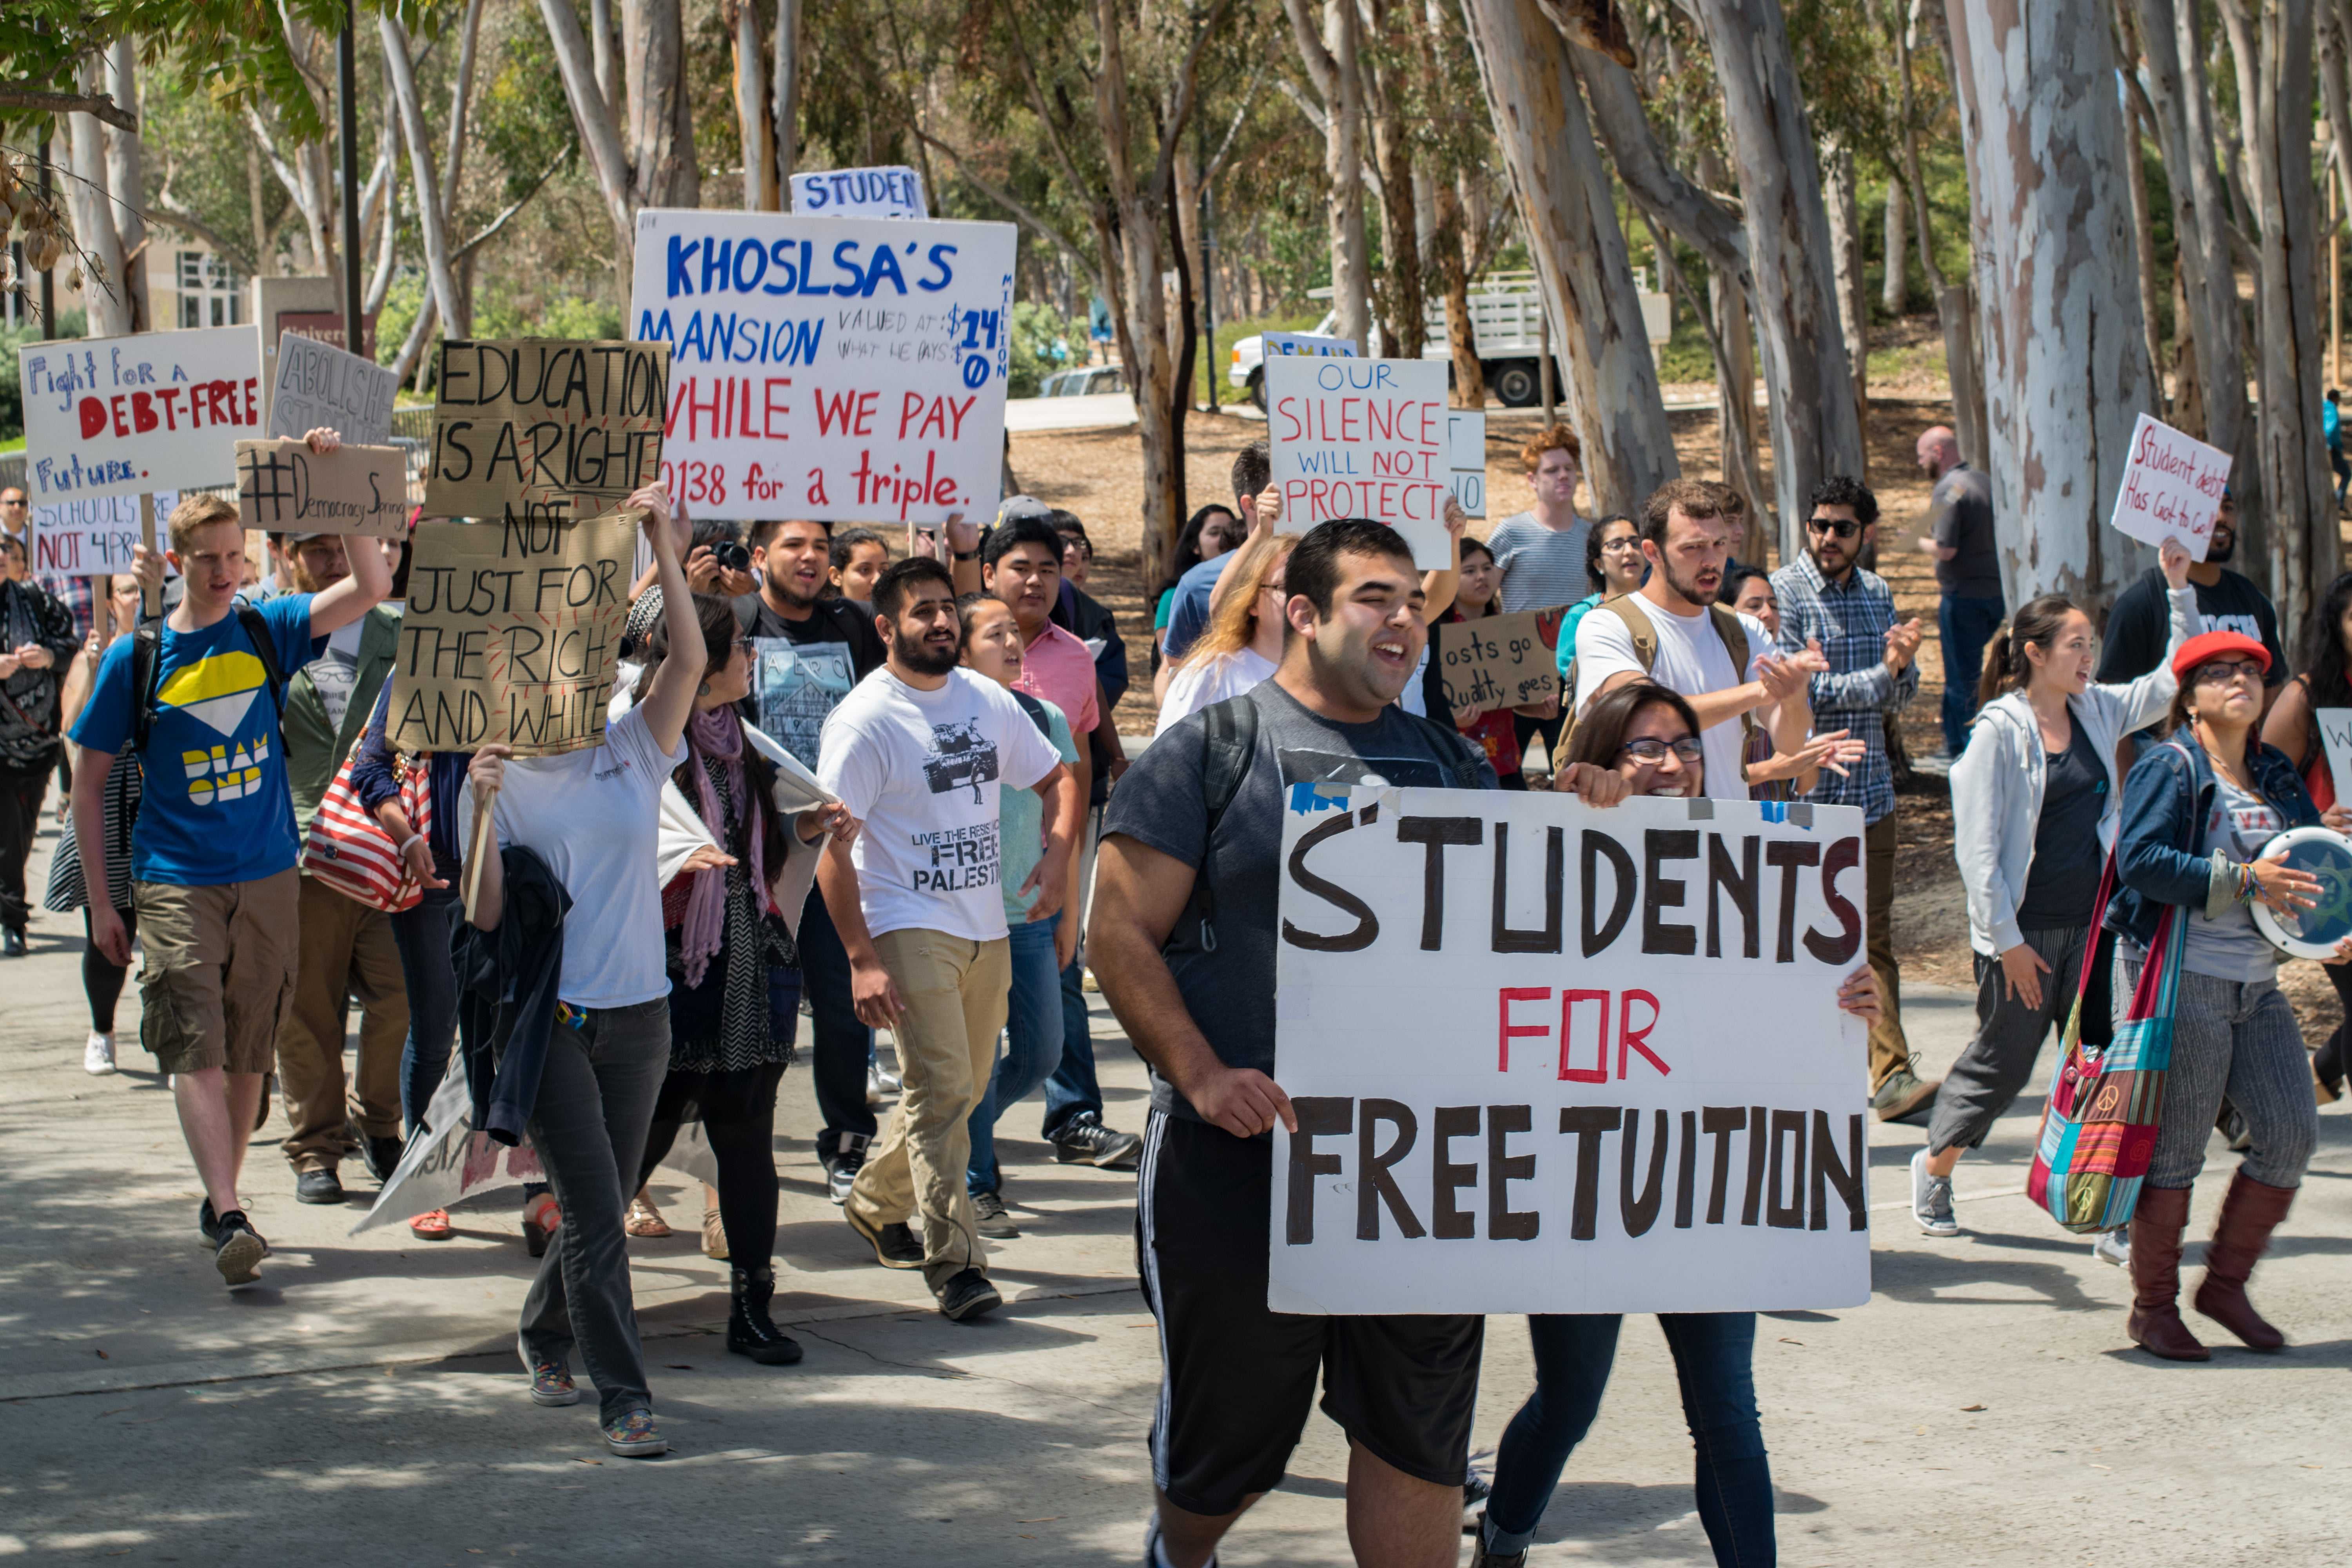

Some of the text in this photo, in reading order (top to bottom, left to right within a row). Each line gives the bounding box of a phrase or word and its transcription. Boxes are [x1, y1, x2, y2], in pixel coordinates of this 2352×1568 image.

[667, 234, 958, 298] KHOSLSA'S
[638, 309, 824, 367] MANSION
[839, 307, 907, 333] VALUED
[838, 338, 879, 360] WHAT
[890, 341, 912, 361] HE
[1318, 364, 1398, 391] OUR
[29, 351, 97, 412] Fight
[79, 376, 258, 440] DEBT-FREE
[441, 342, 671, 423] EDUCATION
[814, 388, 881, 437] WE
[898, 391, 977, 442] PAY
[1278, 396, 1440, 446] SILENCE
[434, 421, 473, 482] IS
[486, 421, 524, 482] A
[1298, 450, 1438, 479] WILL NOT
[2134, 424, 2196, 485] Student
[742, 462, 784, 502] for
[807, 467, 830, 506] a
[850, 450, 970, 521] triple.
[1285, 479, 1444, 523] PROTECT
[2125, 470, 2149, 510] Has
[2180, 500, 2189, 528] to
[38, 531, 84, 570] NOT
[502, 500, 571, 558] NOT
[410, 559, 618, 616] JUST FOR
[404, 624, 607, 682] THE RICH
[1509, 637, 1531, 664] go
[395, 682, 611, 745] AND WHITE
[1517, 674, 1553, 702] goes
[911, 832, 940, 846] LIVE
[944, 828, 967, 843] THE
[931, 834, 998, 868] FREE
[1281, 802, 1862, 965] STUDENTS
[1497, 986, 1671, 1084] FOR
[1286, 1096, 1868, 1247] FREE TUITION
